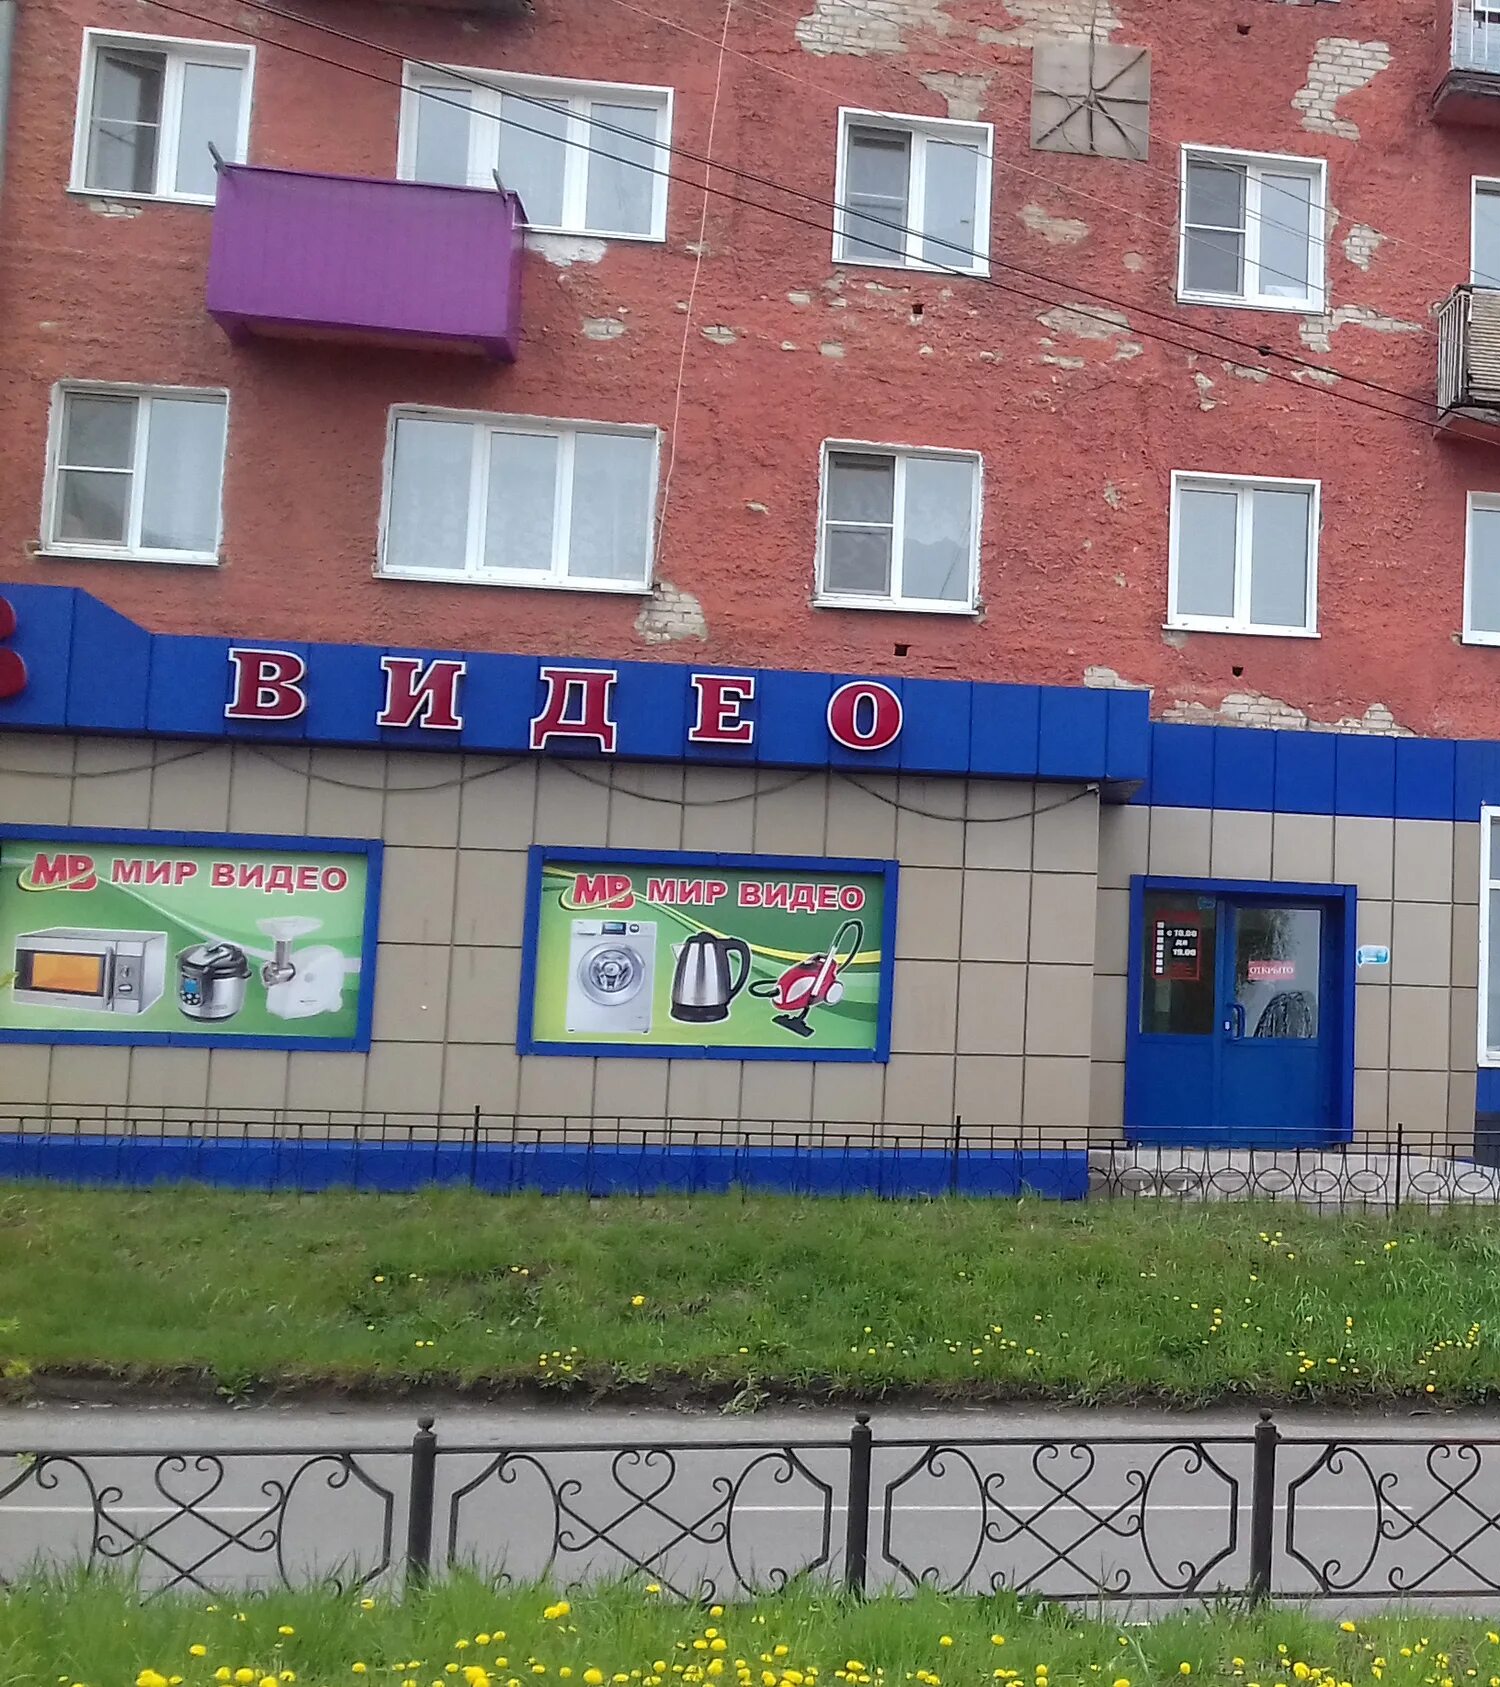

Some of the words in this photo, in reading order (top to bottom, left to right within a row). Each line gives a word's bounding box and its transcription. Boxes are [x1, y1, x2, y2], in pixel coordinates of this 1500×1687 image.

[225, 648, 904, 754] ВИДЕО
[112, 859, 198, 885] МИР
[211, 862, 348, 894] ВИДЕО
[647, 878, 728, 905] МИР
[738, 882, 866, 914] ВИДЕО
